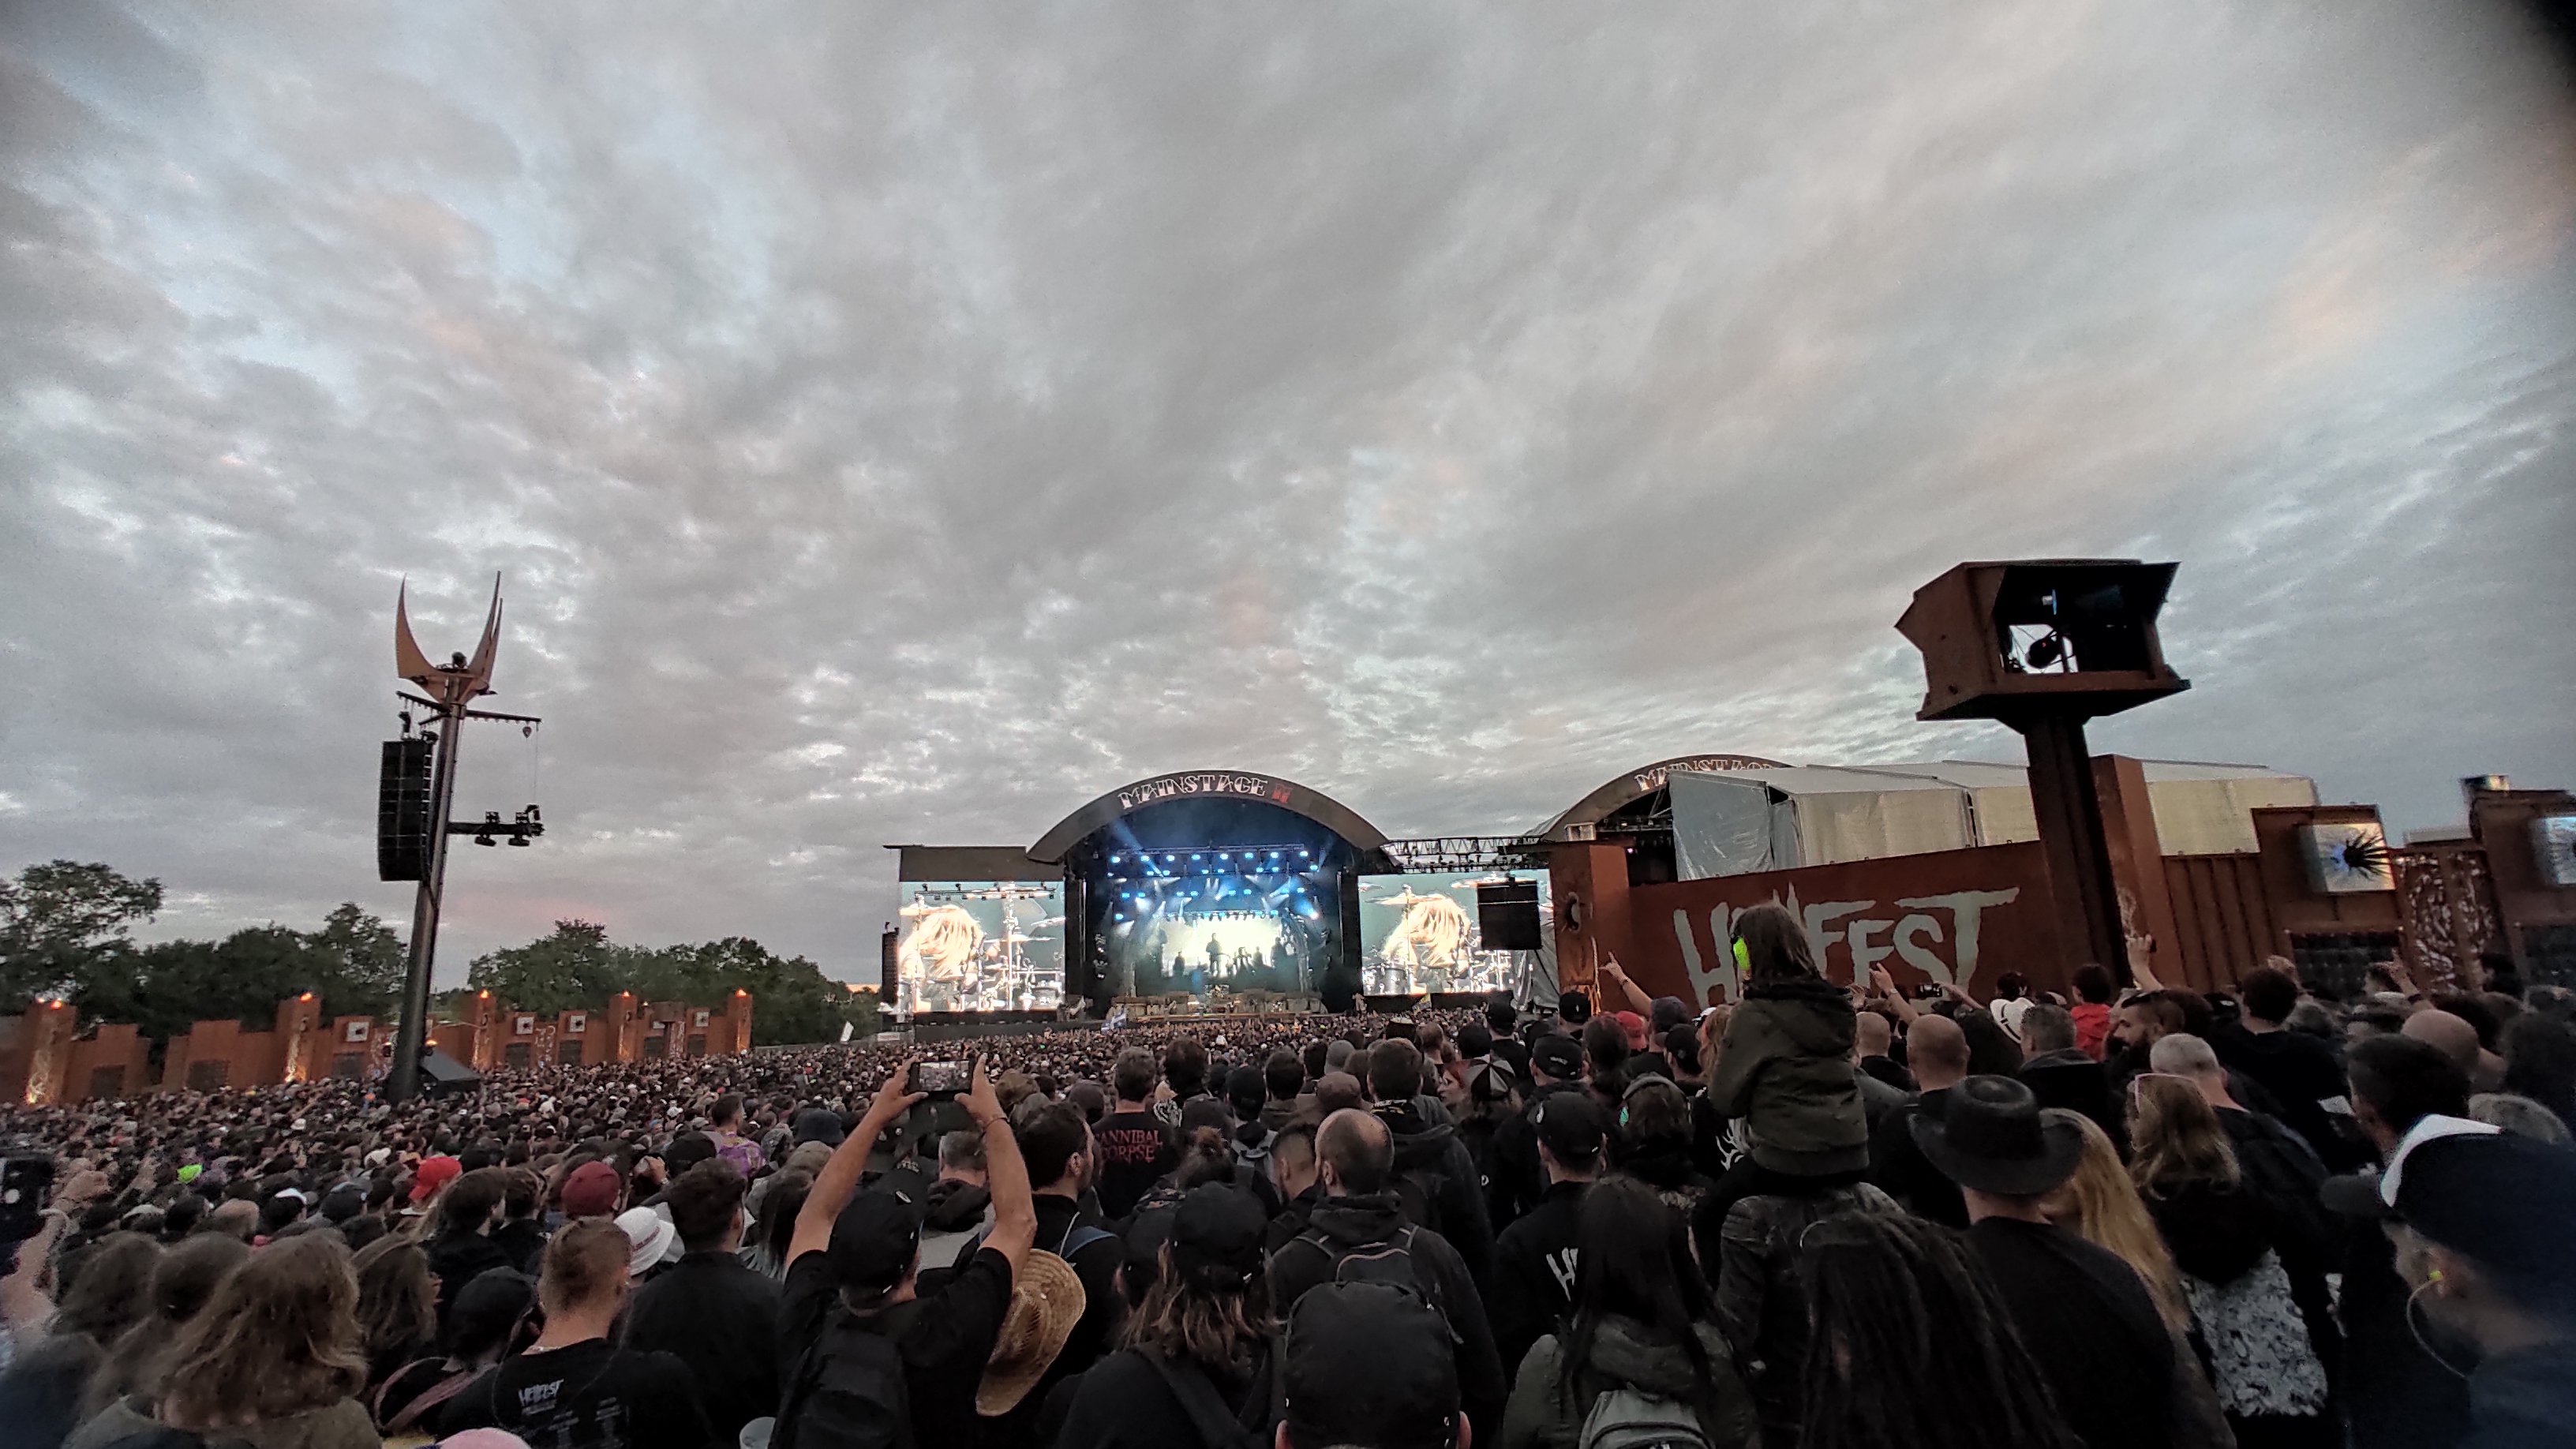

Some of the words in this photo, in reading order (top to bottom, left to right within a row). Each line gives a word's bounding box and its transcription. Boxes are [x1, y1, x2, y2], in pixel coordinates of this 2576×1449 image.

[1117, 774, 1268, 810] MAINSTAGE
[1673, 881, 2020, 1014] HFEST
[1096, 1129, 1163, 1145] ANNIBAL
